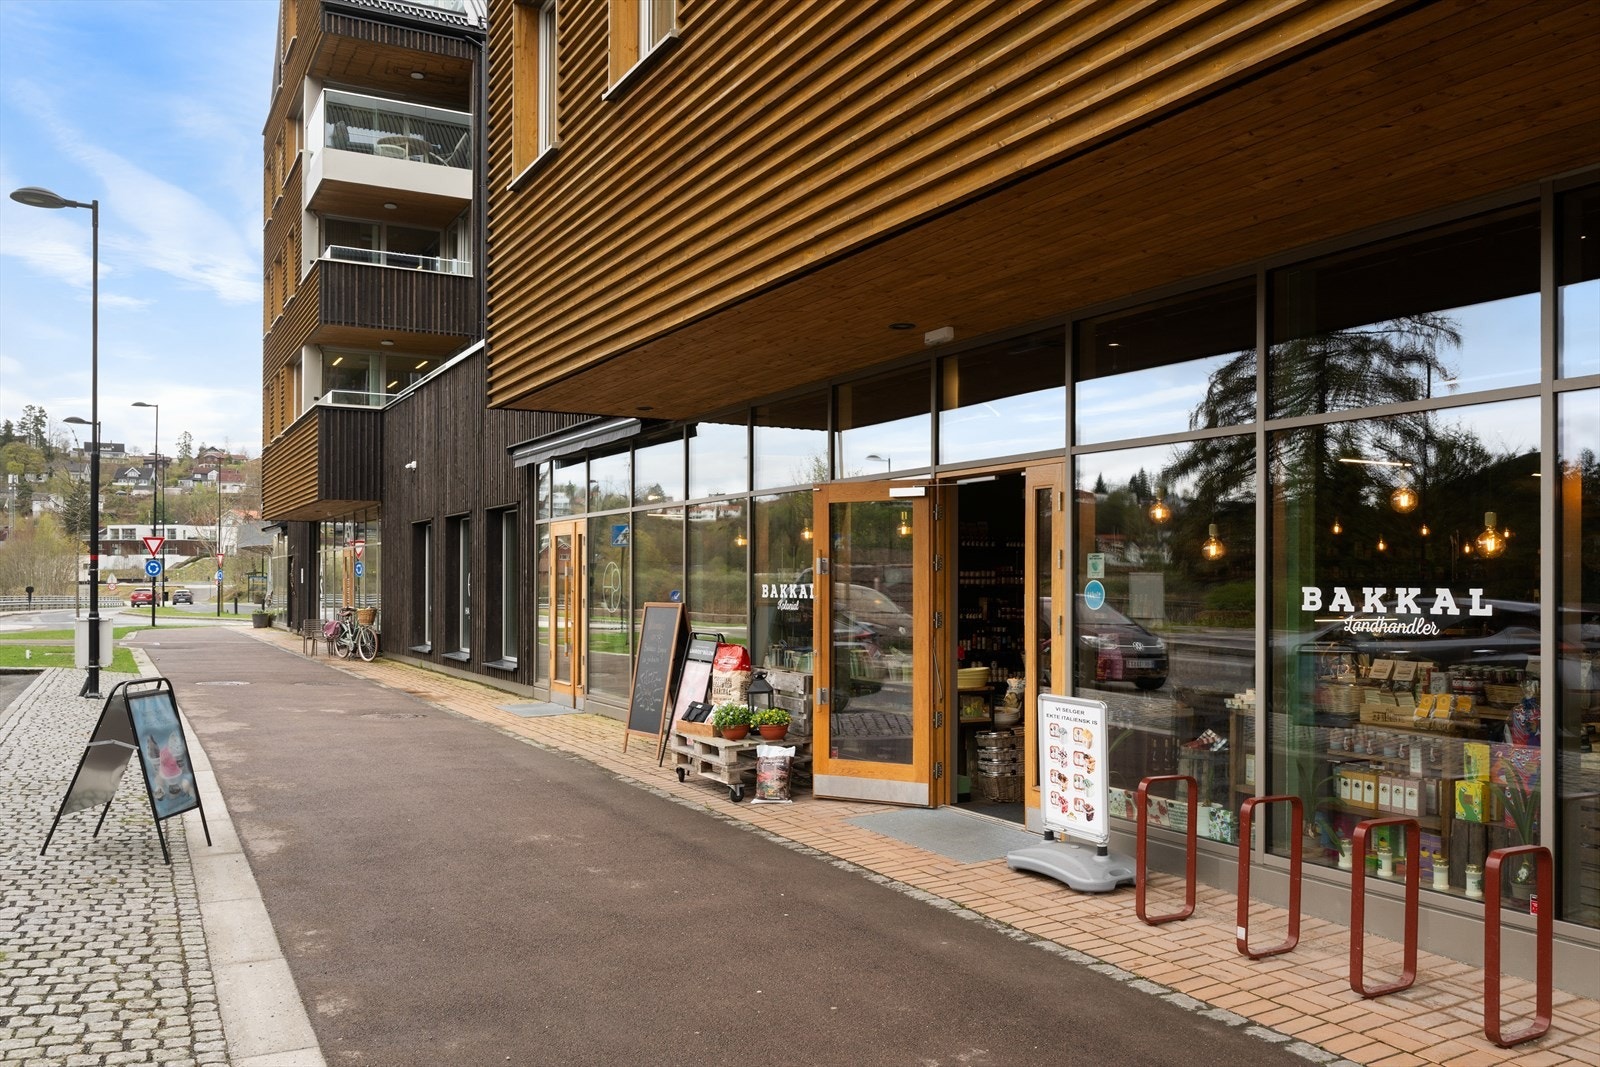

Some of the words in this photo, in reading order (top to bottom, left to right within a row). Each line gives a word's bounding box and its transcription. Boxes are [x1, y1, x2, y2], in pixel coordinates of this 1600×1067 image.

[777, 599, 800, 611] Kolonial
[1301, 586, 1493, 617] BAKKAL
[1344, 616, 1440, 635] Landhandler
[1062, 707, 1085, 715] SELGER
[1061, 715, 1091, 724] ITALIENSK
